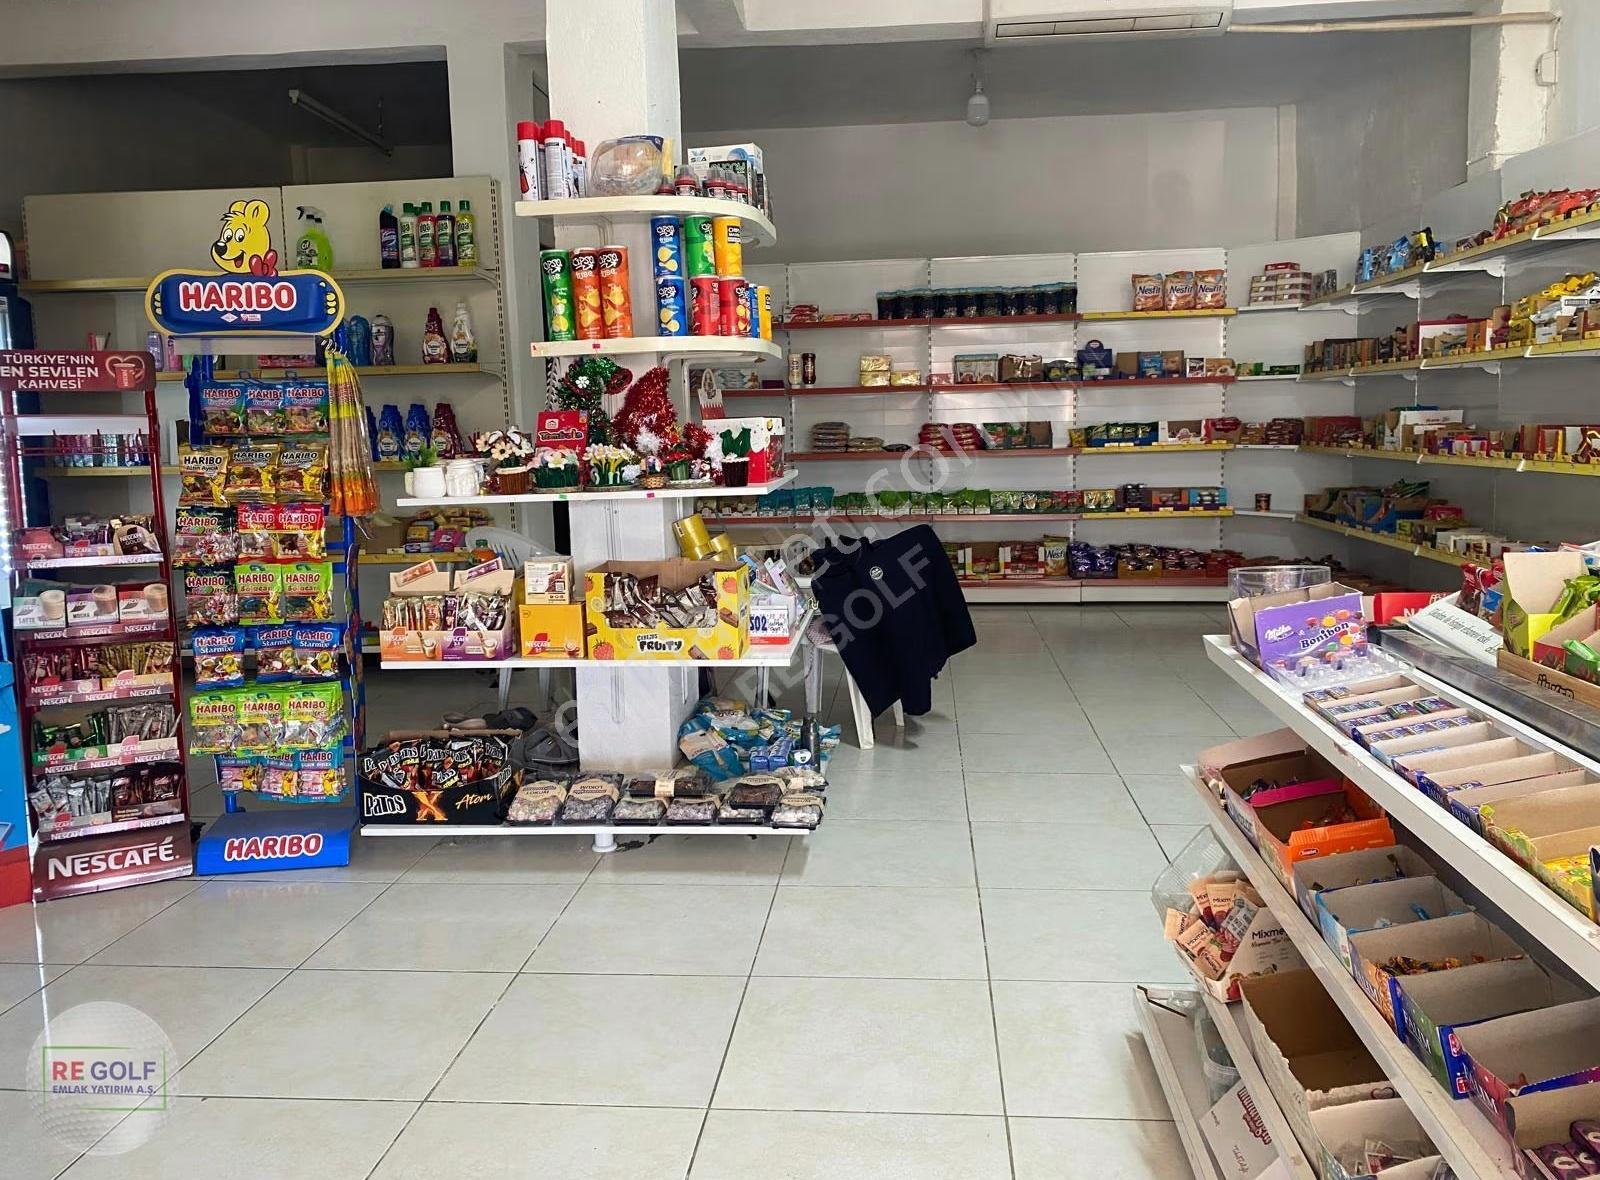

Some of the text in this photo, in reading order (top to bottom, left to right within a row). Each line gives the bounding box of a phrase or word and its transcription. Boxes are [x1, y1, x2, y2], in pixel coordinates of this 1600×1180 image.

[180, 282, 297, 311] HARIBO
[0, 366, 24, 378] EN
[204, 388, 241, 399] HARIBO
[287, 387, 325, 398] HARIBO
[184, 455, 223, 466] HARIBO
[233, 451, 272, 460] HARIBO
[281, 452, 318, 460] HARIBO
[178, 517, 218, 527] HARIBO
[243, 512, 275, 524] HARIB
[279, 512, 316, 524] HARIBO
[187, 576, 225, 587] HARIBO
[238, 573, 274, 583] HARIBO
[285, 573, 320, 583] HARIBO
[296, 631, 333, 641] HARIBO
[1264, 624, 1293, 641] Milka
[1300, 622, 1350, 649] Bonibon
[195, 636, 236, 647] HARIBO
[261, 638, 293, 647] Starmix
[299, 639, 330, 648] Starmix
[639, 640, 683, 651] FRUITY
[200, 646, 234, 654] Starmix
[196, 703, 236, 714] HARIBO
[243, 702, 281, 711] HARIBO
[288, 700, 326, 710] HARIBO
[300, 752, 333, 761] HARIBO
[411, 790, 448, 821] X
[455, 791, 493, 811] Atom
[225, 834, 323, 862] HARIBO
[48, 836, 176, 881] NESCAFÉ
